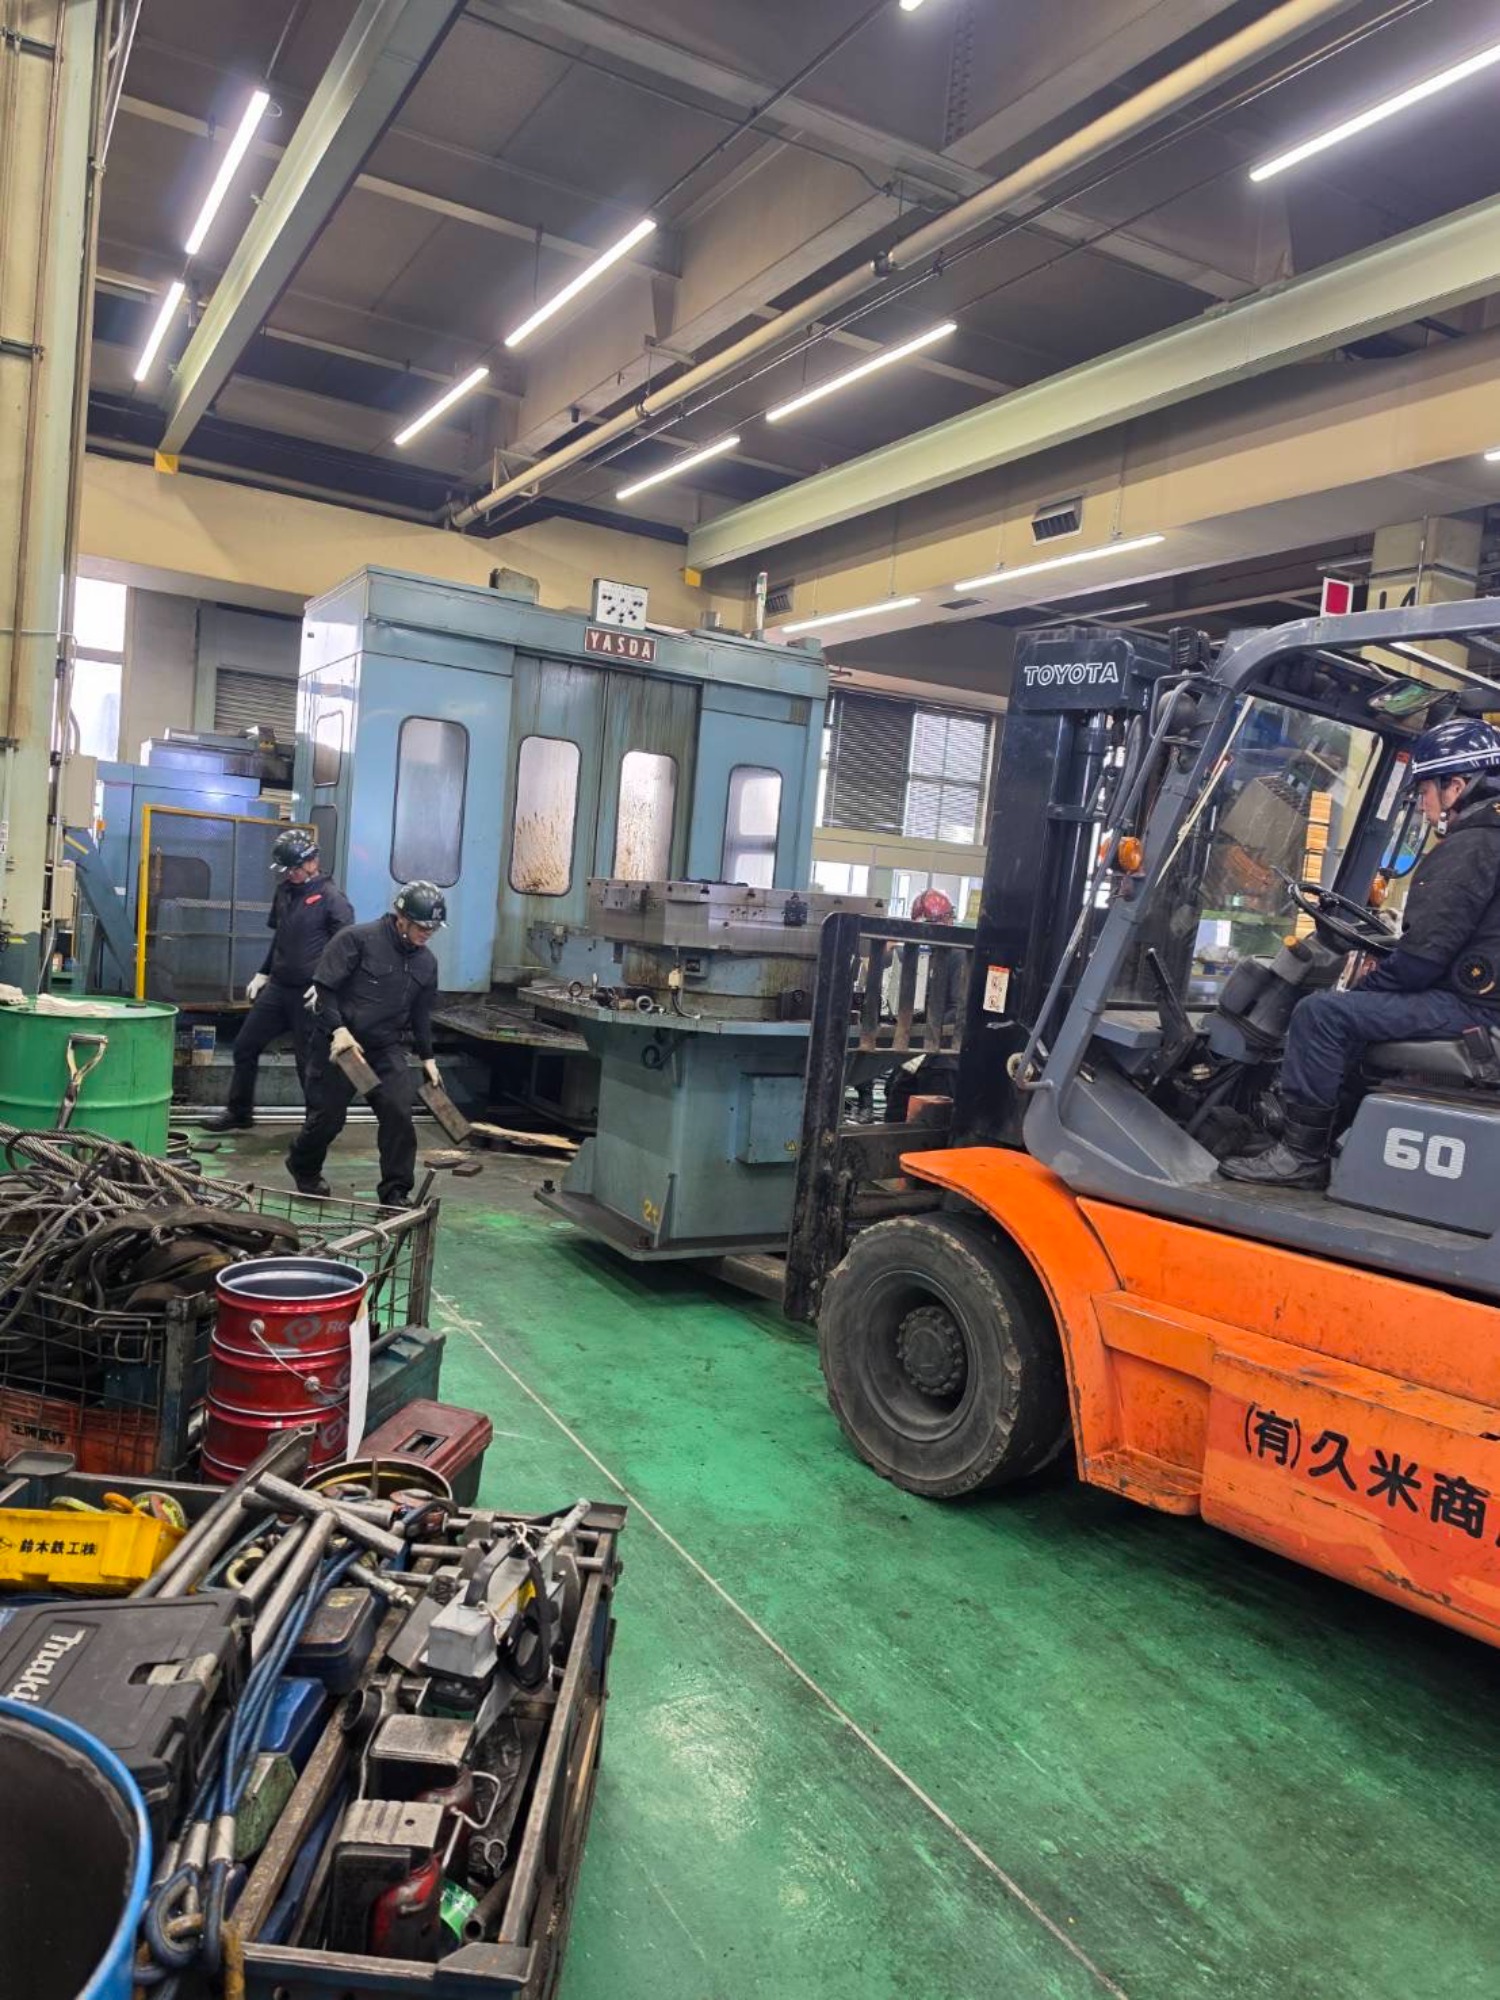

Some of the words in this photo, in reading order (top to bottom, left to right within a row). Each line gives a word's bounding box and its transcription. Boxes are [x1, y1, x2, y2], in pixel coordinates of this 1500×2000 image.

[590, 631, 652, 659] YASDA
[1024, 661, 1119, 686] TOYOTA
[1383, 1127, 1466, 1180] 60
[1245, 1401, 1500, 1548] (有)久米商
[8, 1628, 86, 1702] maki
